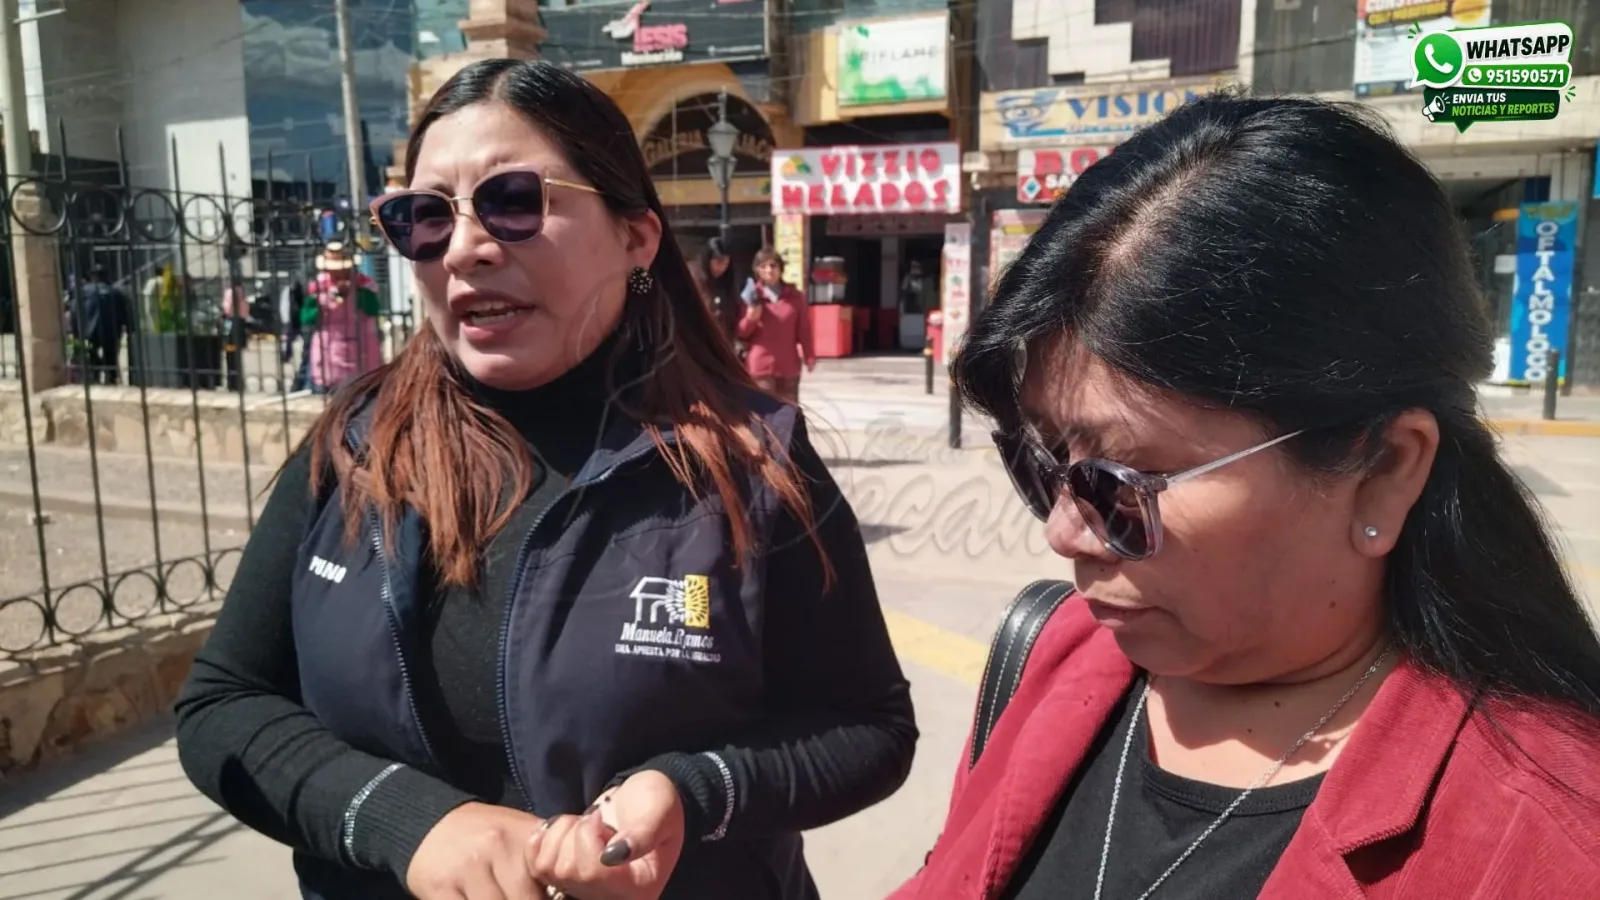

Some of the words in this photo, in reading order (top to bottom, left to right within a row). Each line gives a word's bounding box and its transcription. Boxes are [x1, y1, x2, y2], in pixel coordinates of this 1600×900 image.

[820, 148, 941, 177] VIZZIO
[1034, 147, 1114, 176] BO
[782, 179, 949, 209] HELADOS
[620, 622, 673, 645] Manuela
[673, 628, 715, 648] Ramos
